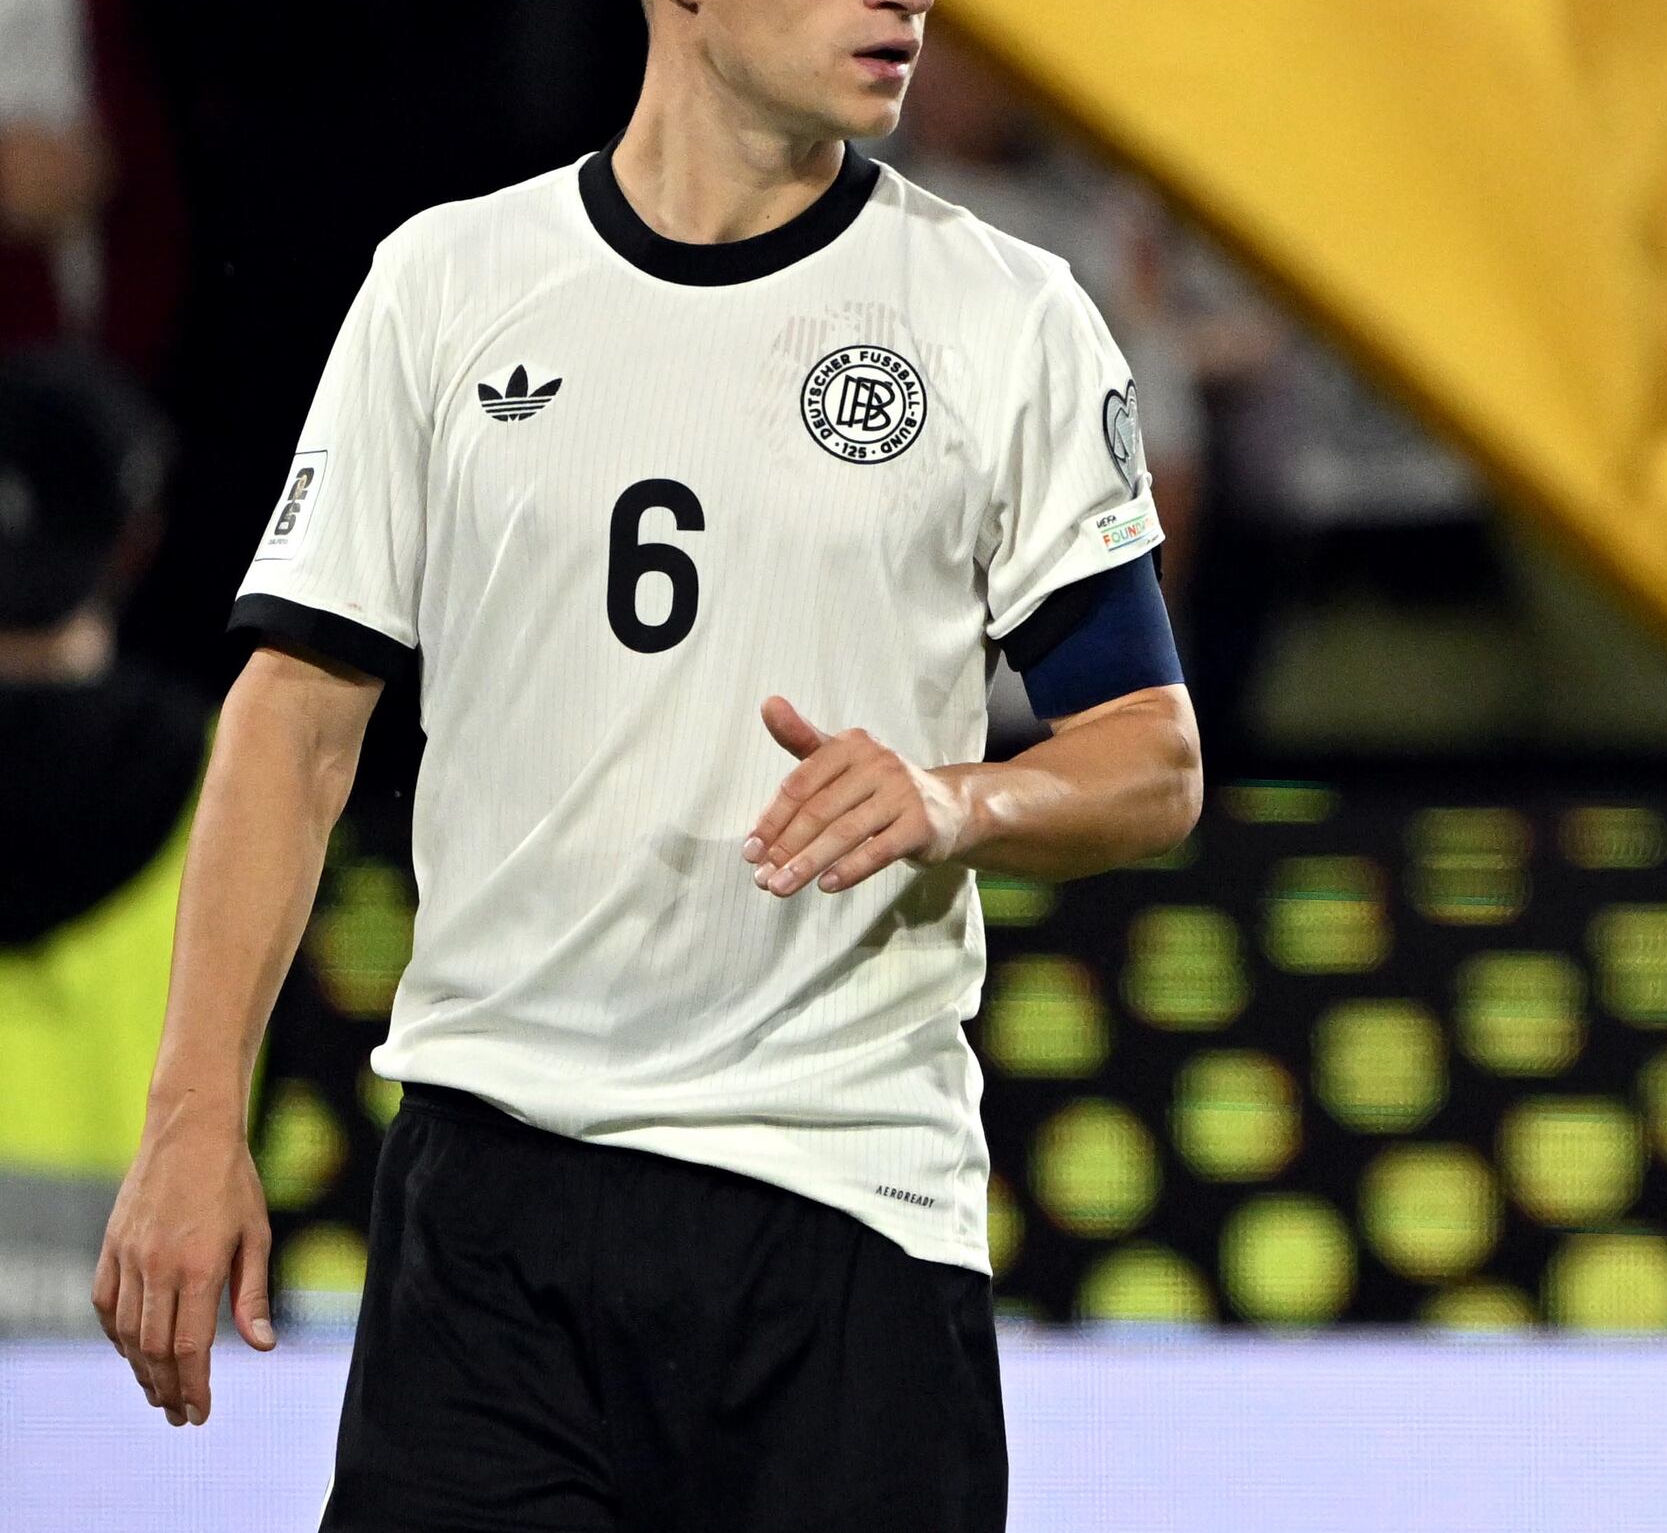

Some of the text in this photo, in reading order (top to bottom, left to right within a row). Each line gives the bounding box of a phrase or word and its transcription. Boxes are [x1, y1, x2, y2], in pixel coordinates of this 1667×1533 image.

[808, 351, 920, 454] DEUTSCHER FUSSBALL-BUND
[842, 442, 867, 459] 125
[606, 478, 706, 655] 6
[875, 1185, 935, 1208] AEROREADY
